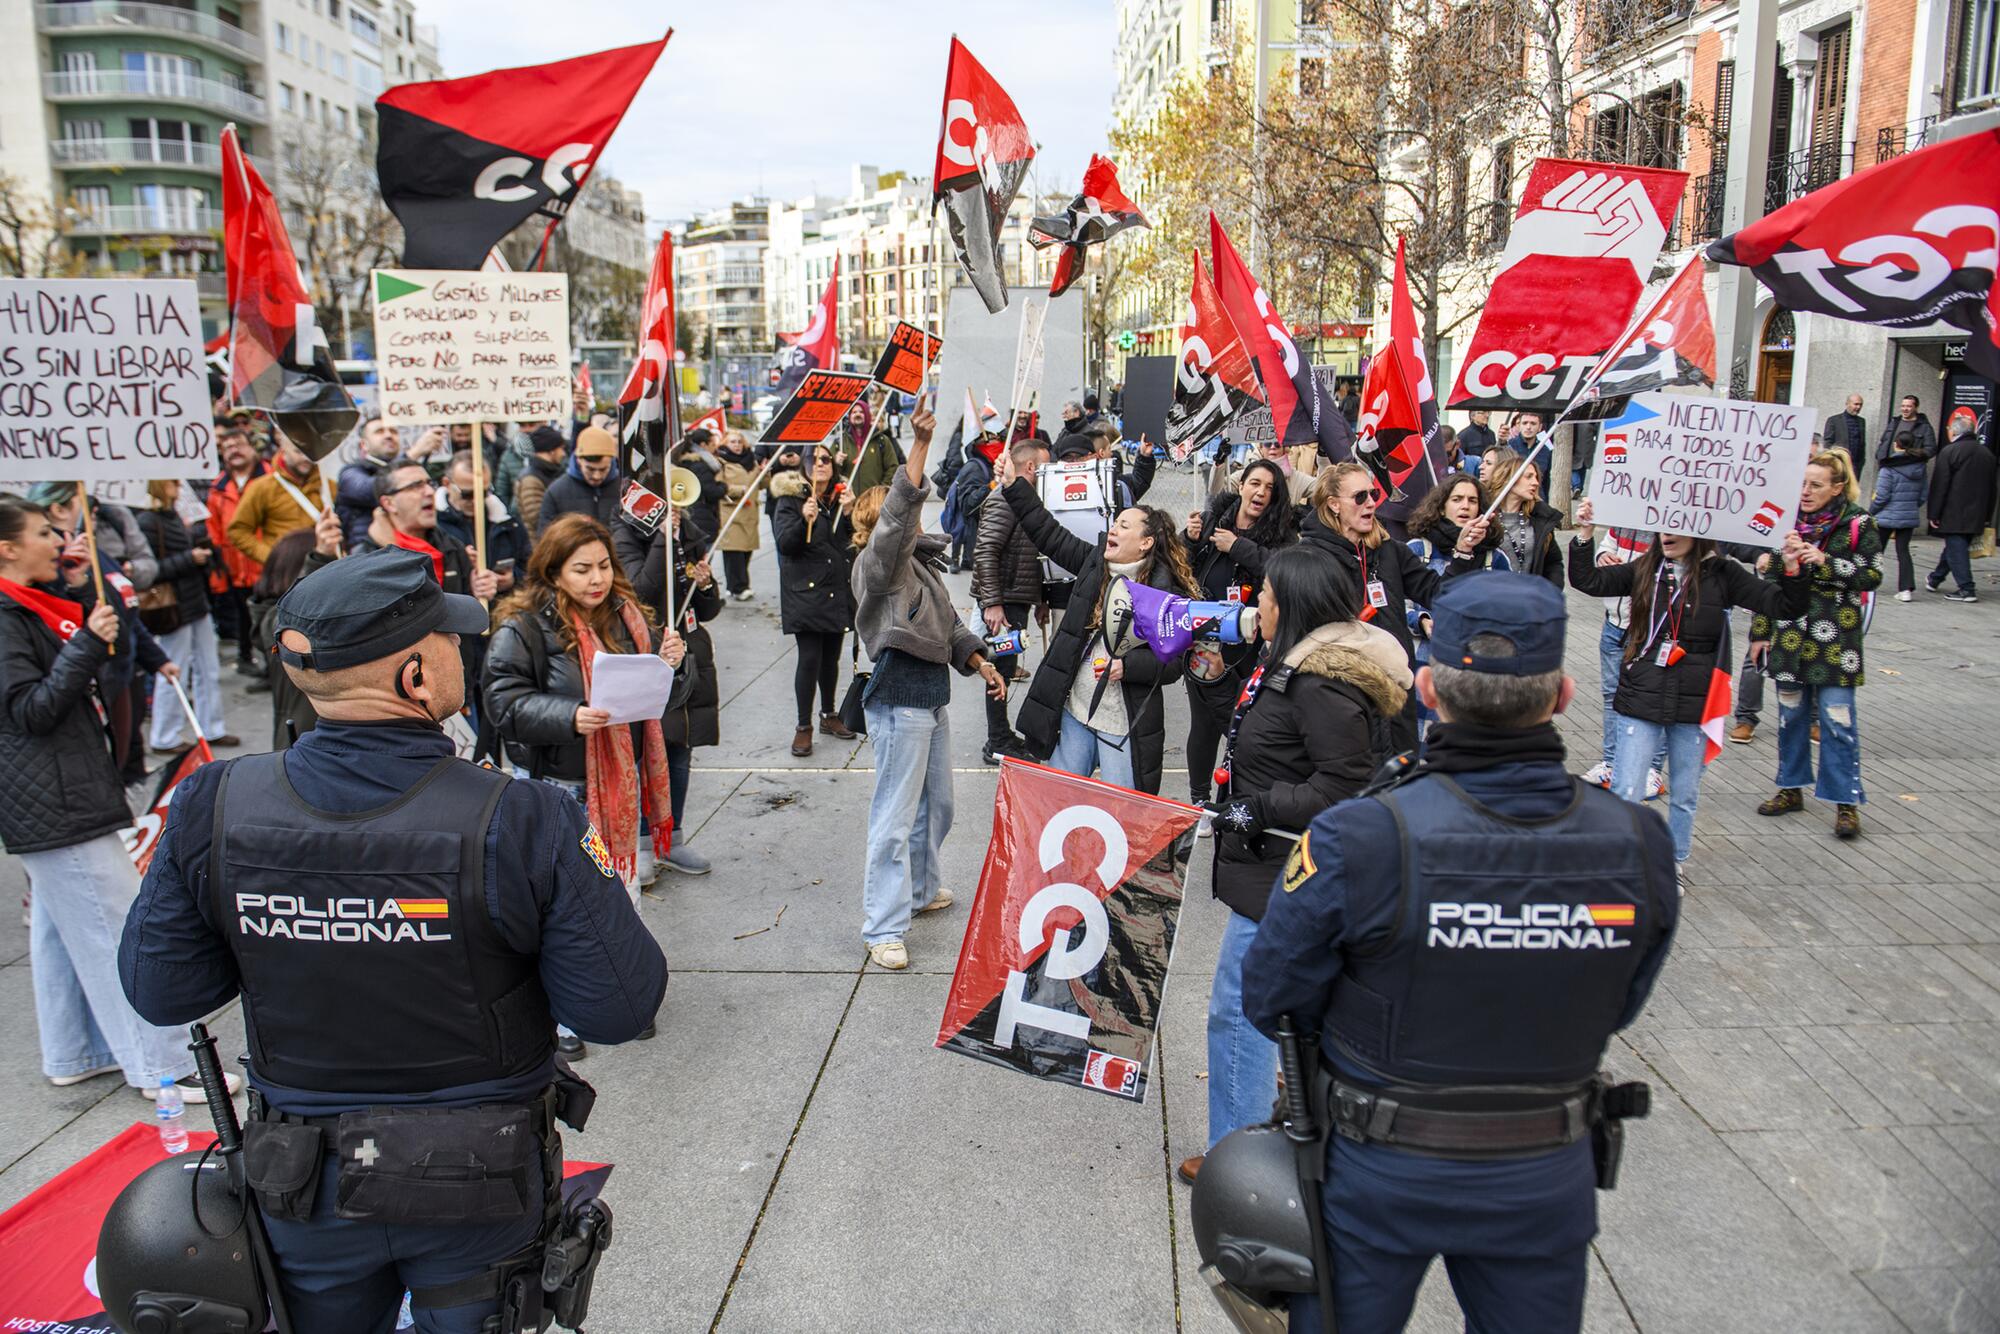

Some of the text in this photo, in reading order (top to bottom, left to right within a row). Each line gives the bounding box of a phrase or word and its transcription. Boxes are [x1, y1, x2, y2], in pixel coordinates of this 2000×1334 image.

[136, 292, 190, 336] HA
[489, 310, 499, 323] Y
[510, 311, 529, 322] EN
[389, 331, 456, 346] COMPRAR
[892, 324, 910, 347] SE
[434, 350, 460, 369] NO
[472, 353, 507, 366] PARA
[520, 353, 559, 367] PASAR
[384, 377, 409, 391] LOS
[414, 376, 480, 390] DOMINGOS
[489, 378, 499, 391] Y
[1464, 351, 1599, 400] CGT
[797, 375, 869, 401] SE VENDE
[87, 427, 126, 460] EL
[136, 420, 210, 469] CULO?
[1635, 429, 1773, 463] PARA TODOS LOS
[1605, 454, 1627, 463] CGT
[1601, 470, 1746, 514] POR UN SUELDO
[1750, 520, 1772, 535] CGT
[995, 642, 1013, 652] CGT
[239, 916, 452, 942] NACIONAL
[1427, 927, 1631, 950] NACIONAL
